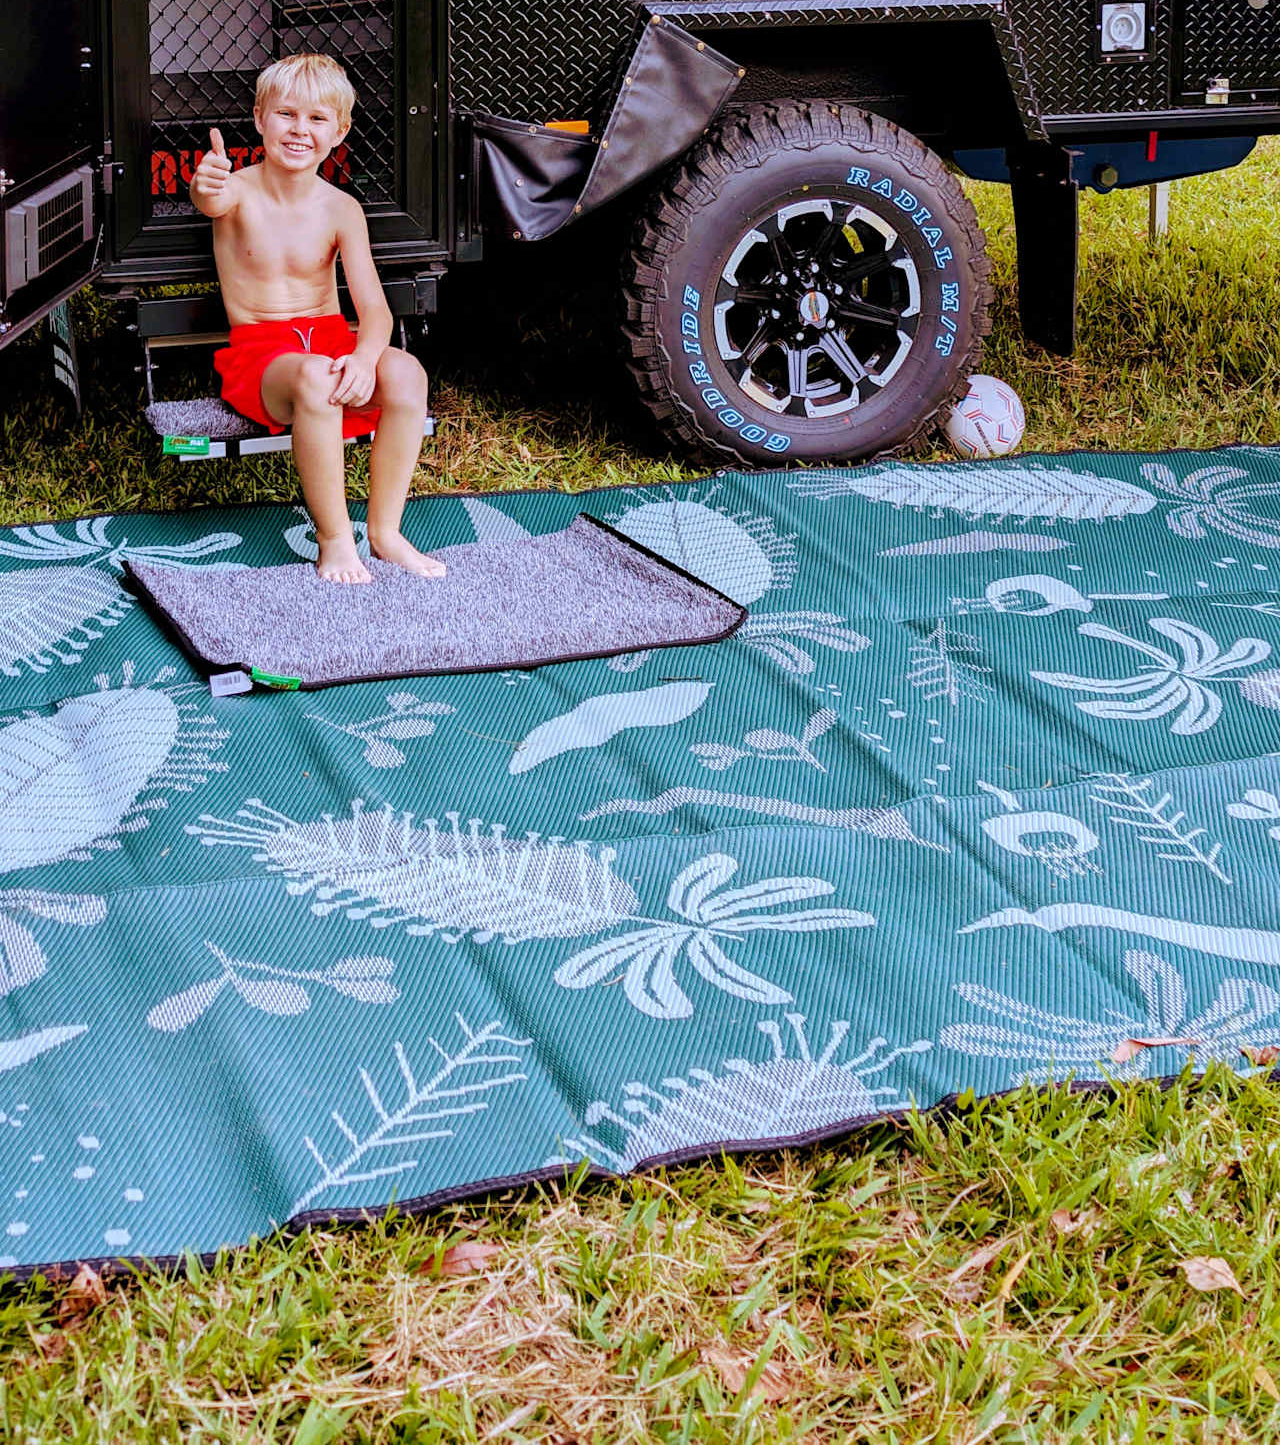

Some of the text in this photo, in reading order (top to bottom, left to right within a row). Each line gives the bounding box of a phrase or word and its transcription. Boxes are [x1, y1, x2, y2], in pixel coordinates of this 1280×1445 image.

[846, 166, 960, 357] RADIAL M/T
[681, 284, 791, 453] GOODRIDE
